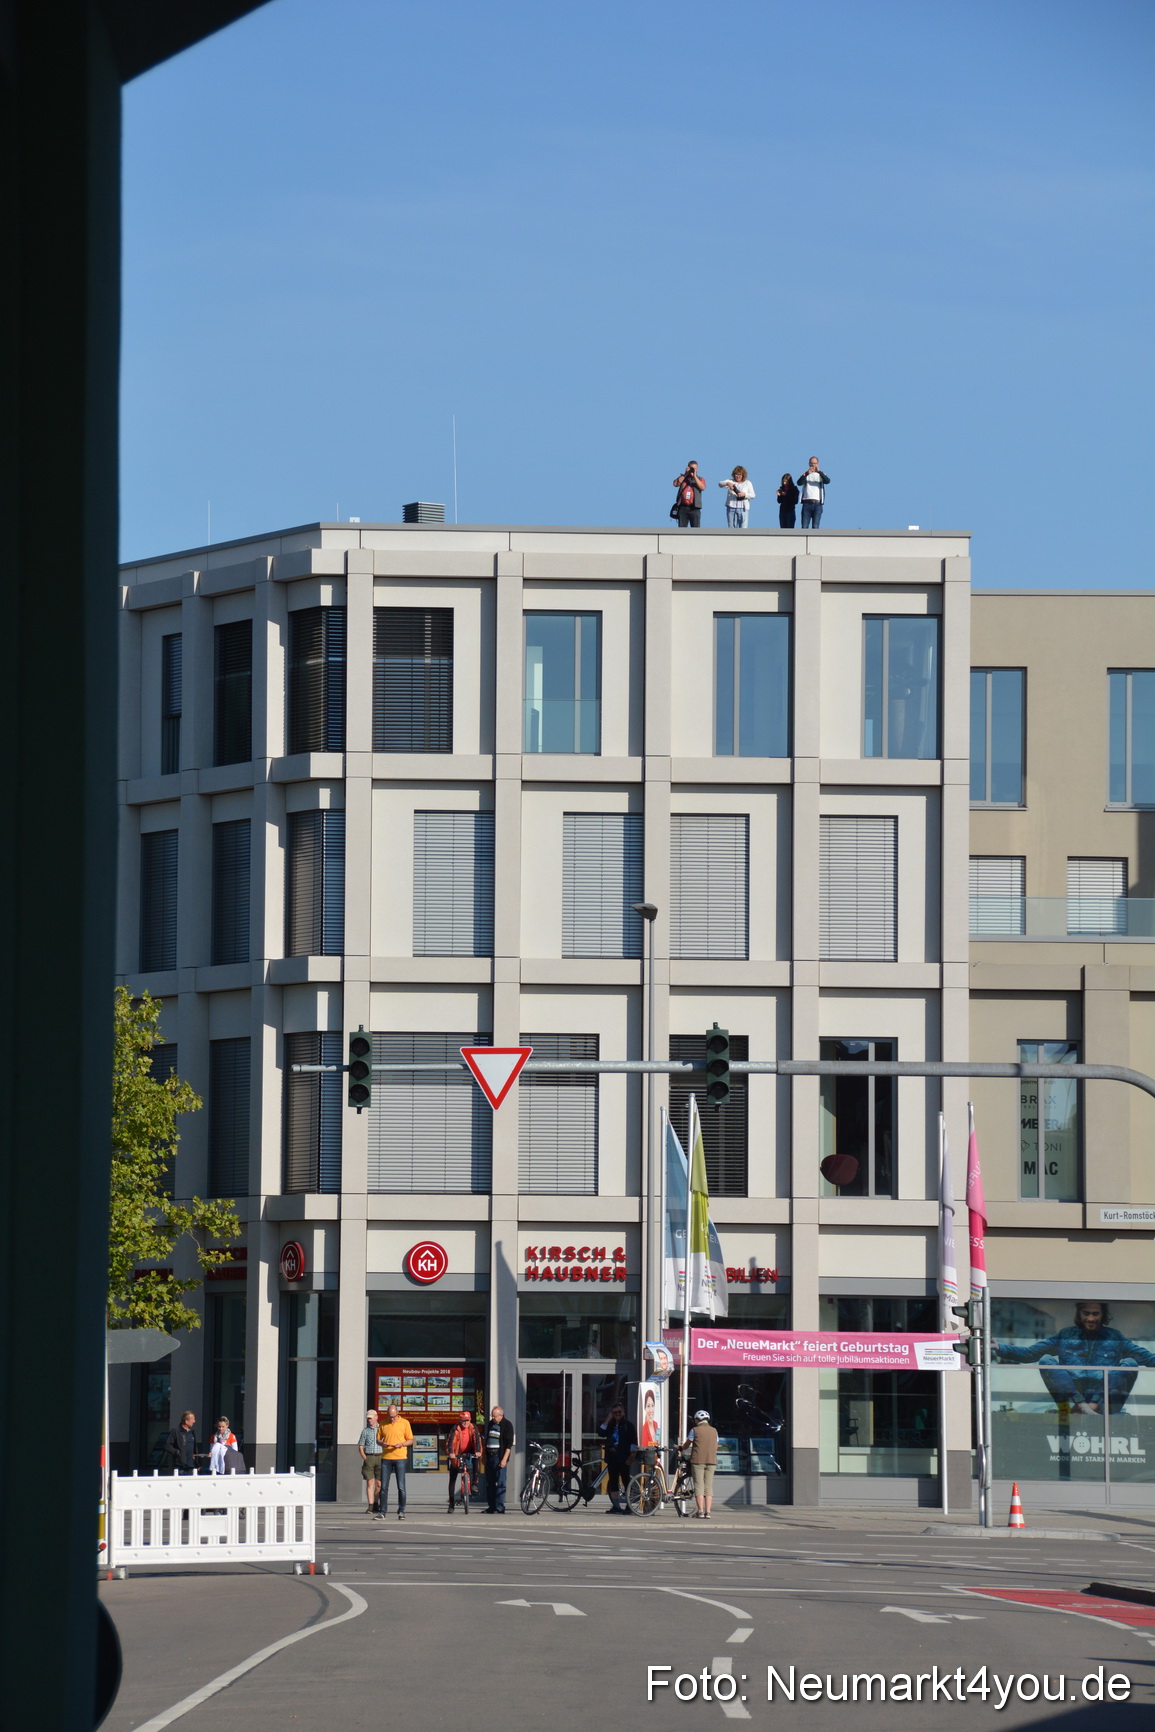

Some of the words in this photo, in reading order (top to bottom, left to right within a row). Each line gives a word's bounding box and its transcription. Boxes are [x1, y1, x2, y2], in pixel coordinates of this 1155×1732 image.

[1021, 1119, 1059, 1130] MEER
[527, 1246, 606, 1261] KIRSCH
[614, 1246, 627, 1261] &
[285, 1259, 296, 1271] KH
[418, 1259, 437, 1271] KH
[527, 1266, 627, 1281] HAUBNER
[726, 1267, 779, 1282] BILIEN
[697, 1338, 719, 1349] Der
[803, 1341, 838, 1352] feiert
[840, 1341, 909, 1355] Geburtstag
[743, 1352, 771, 1361] Freuen
[772, 1353, 785, 1362] Sie
[786, 1353, 802, 1362] sich
[803, 1354, 816, 1363] auf
[818, 1354, 836, 1363] tolle
[837, 1355, 910, 1365] Jubiläumsaktionen
[1046, 1431, 1146, 1455] WÖHRL
